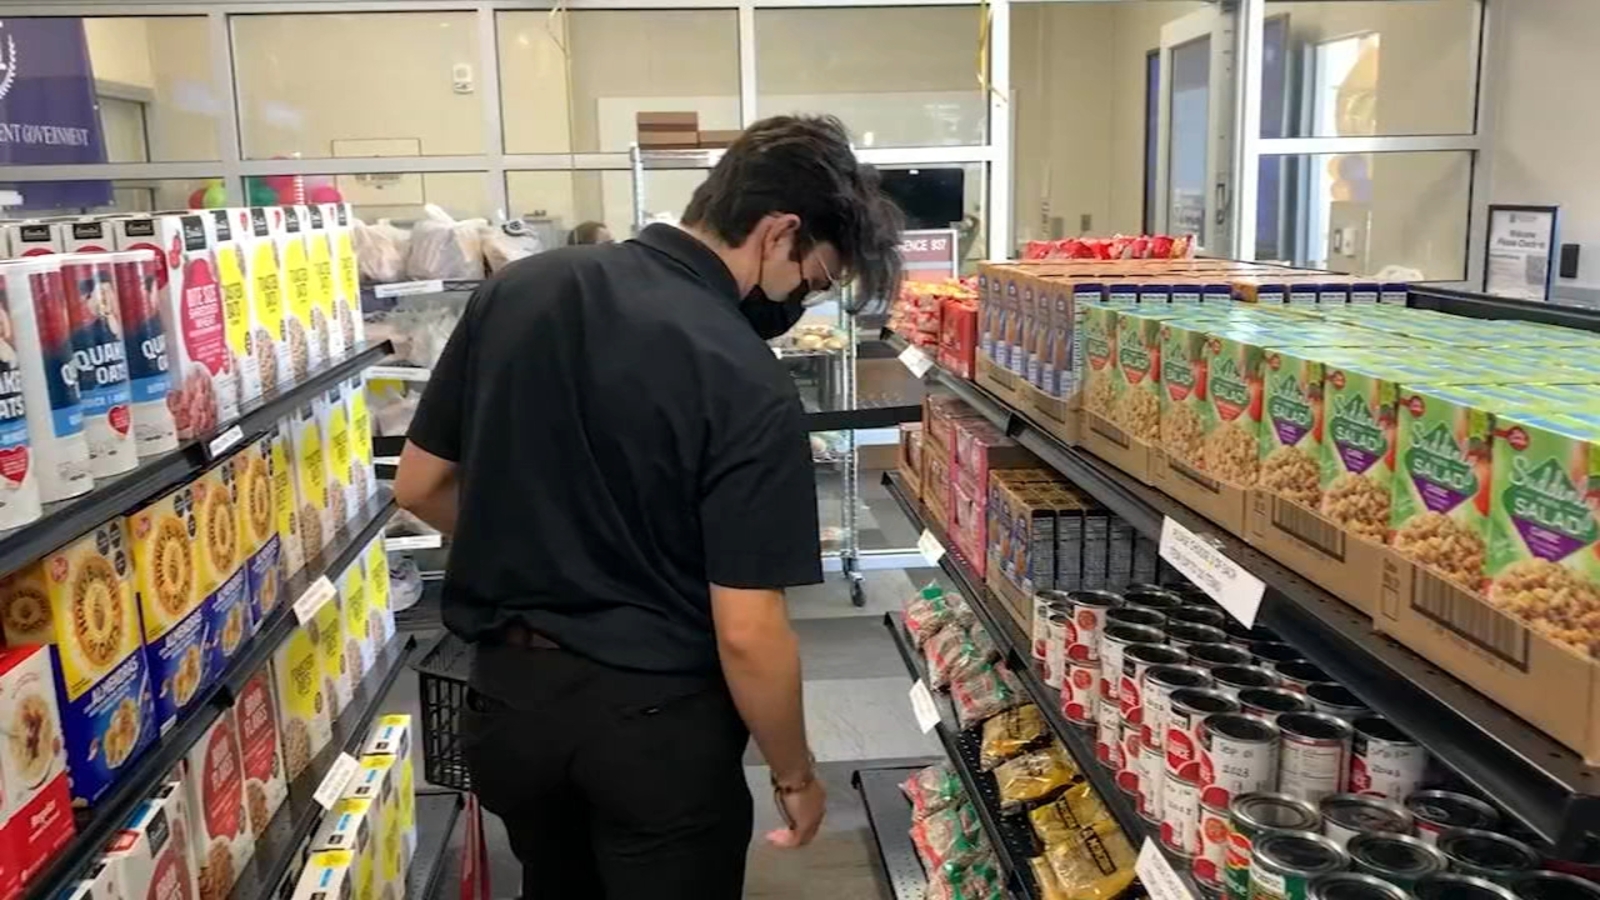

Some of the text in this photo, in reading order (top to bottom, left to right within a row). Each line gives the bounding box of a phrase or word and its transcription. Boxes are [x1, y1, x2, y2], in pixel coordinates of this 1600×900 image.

[22, 124, 89, 147] GOVERNMENT
[1335, 426, 1377, 452] SALAD
[1413, 459, 1465, 489] SALAD
[1514, 497, 1583, 537] SALAD
